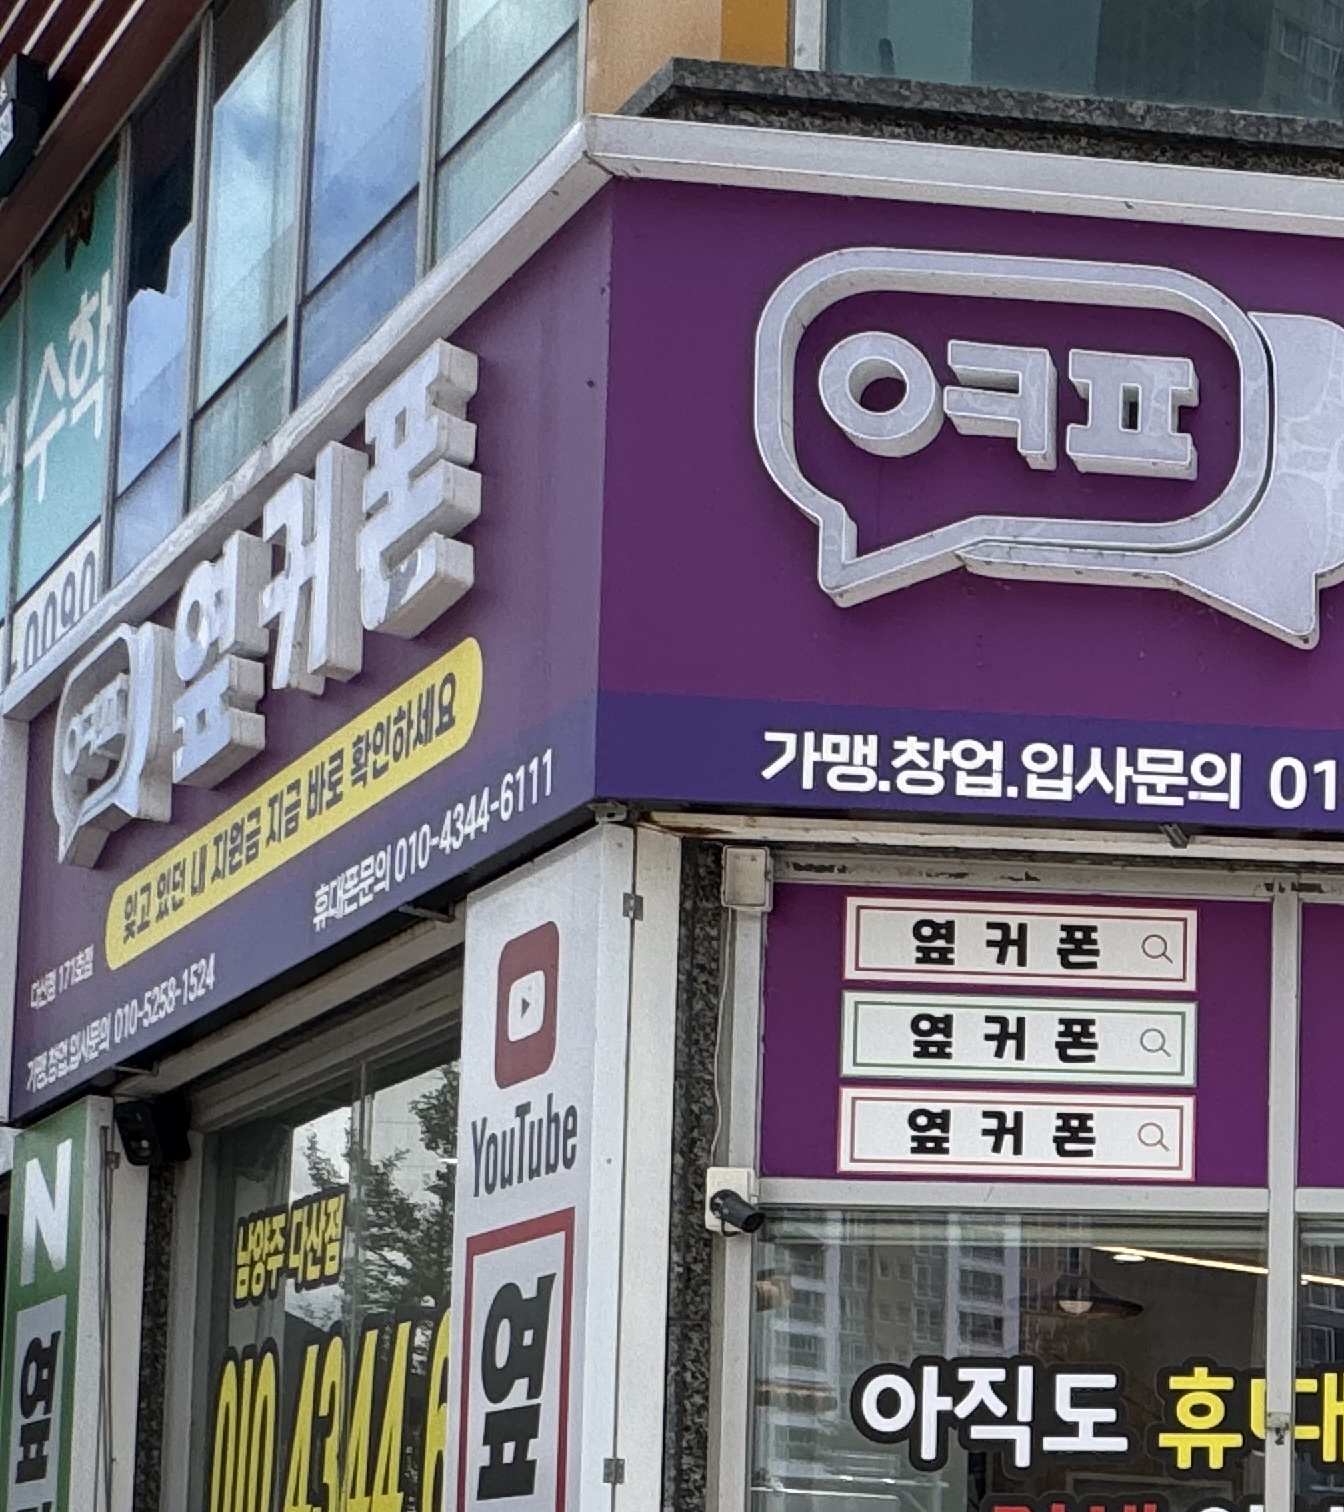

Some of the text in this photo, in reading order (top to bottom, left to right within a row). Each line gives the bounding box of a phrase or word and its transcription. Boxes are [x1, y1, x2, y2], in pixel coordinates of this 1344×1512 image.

[173, 338, 482, 789] 옆커폰
[122, 672, 456, 944] 잊고 있던 내 지원금 지금 바로 확인하세요
[760, 728, 1241, 812] 가맹.창업.입사문의
[313, 748, 553, 932] 휴대폰문의 010-4344-6111
[114, 953, 215, 1043] 010-5258-1524
[471, 1094, 578, 1196] YouTube
[20, 1139, 73, 1287] N
[235, 1193, 346, 1300] 남양주 다산점
[861, 1365, 1128, 1469] 아직도
